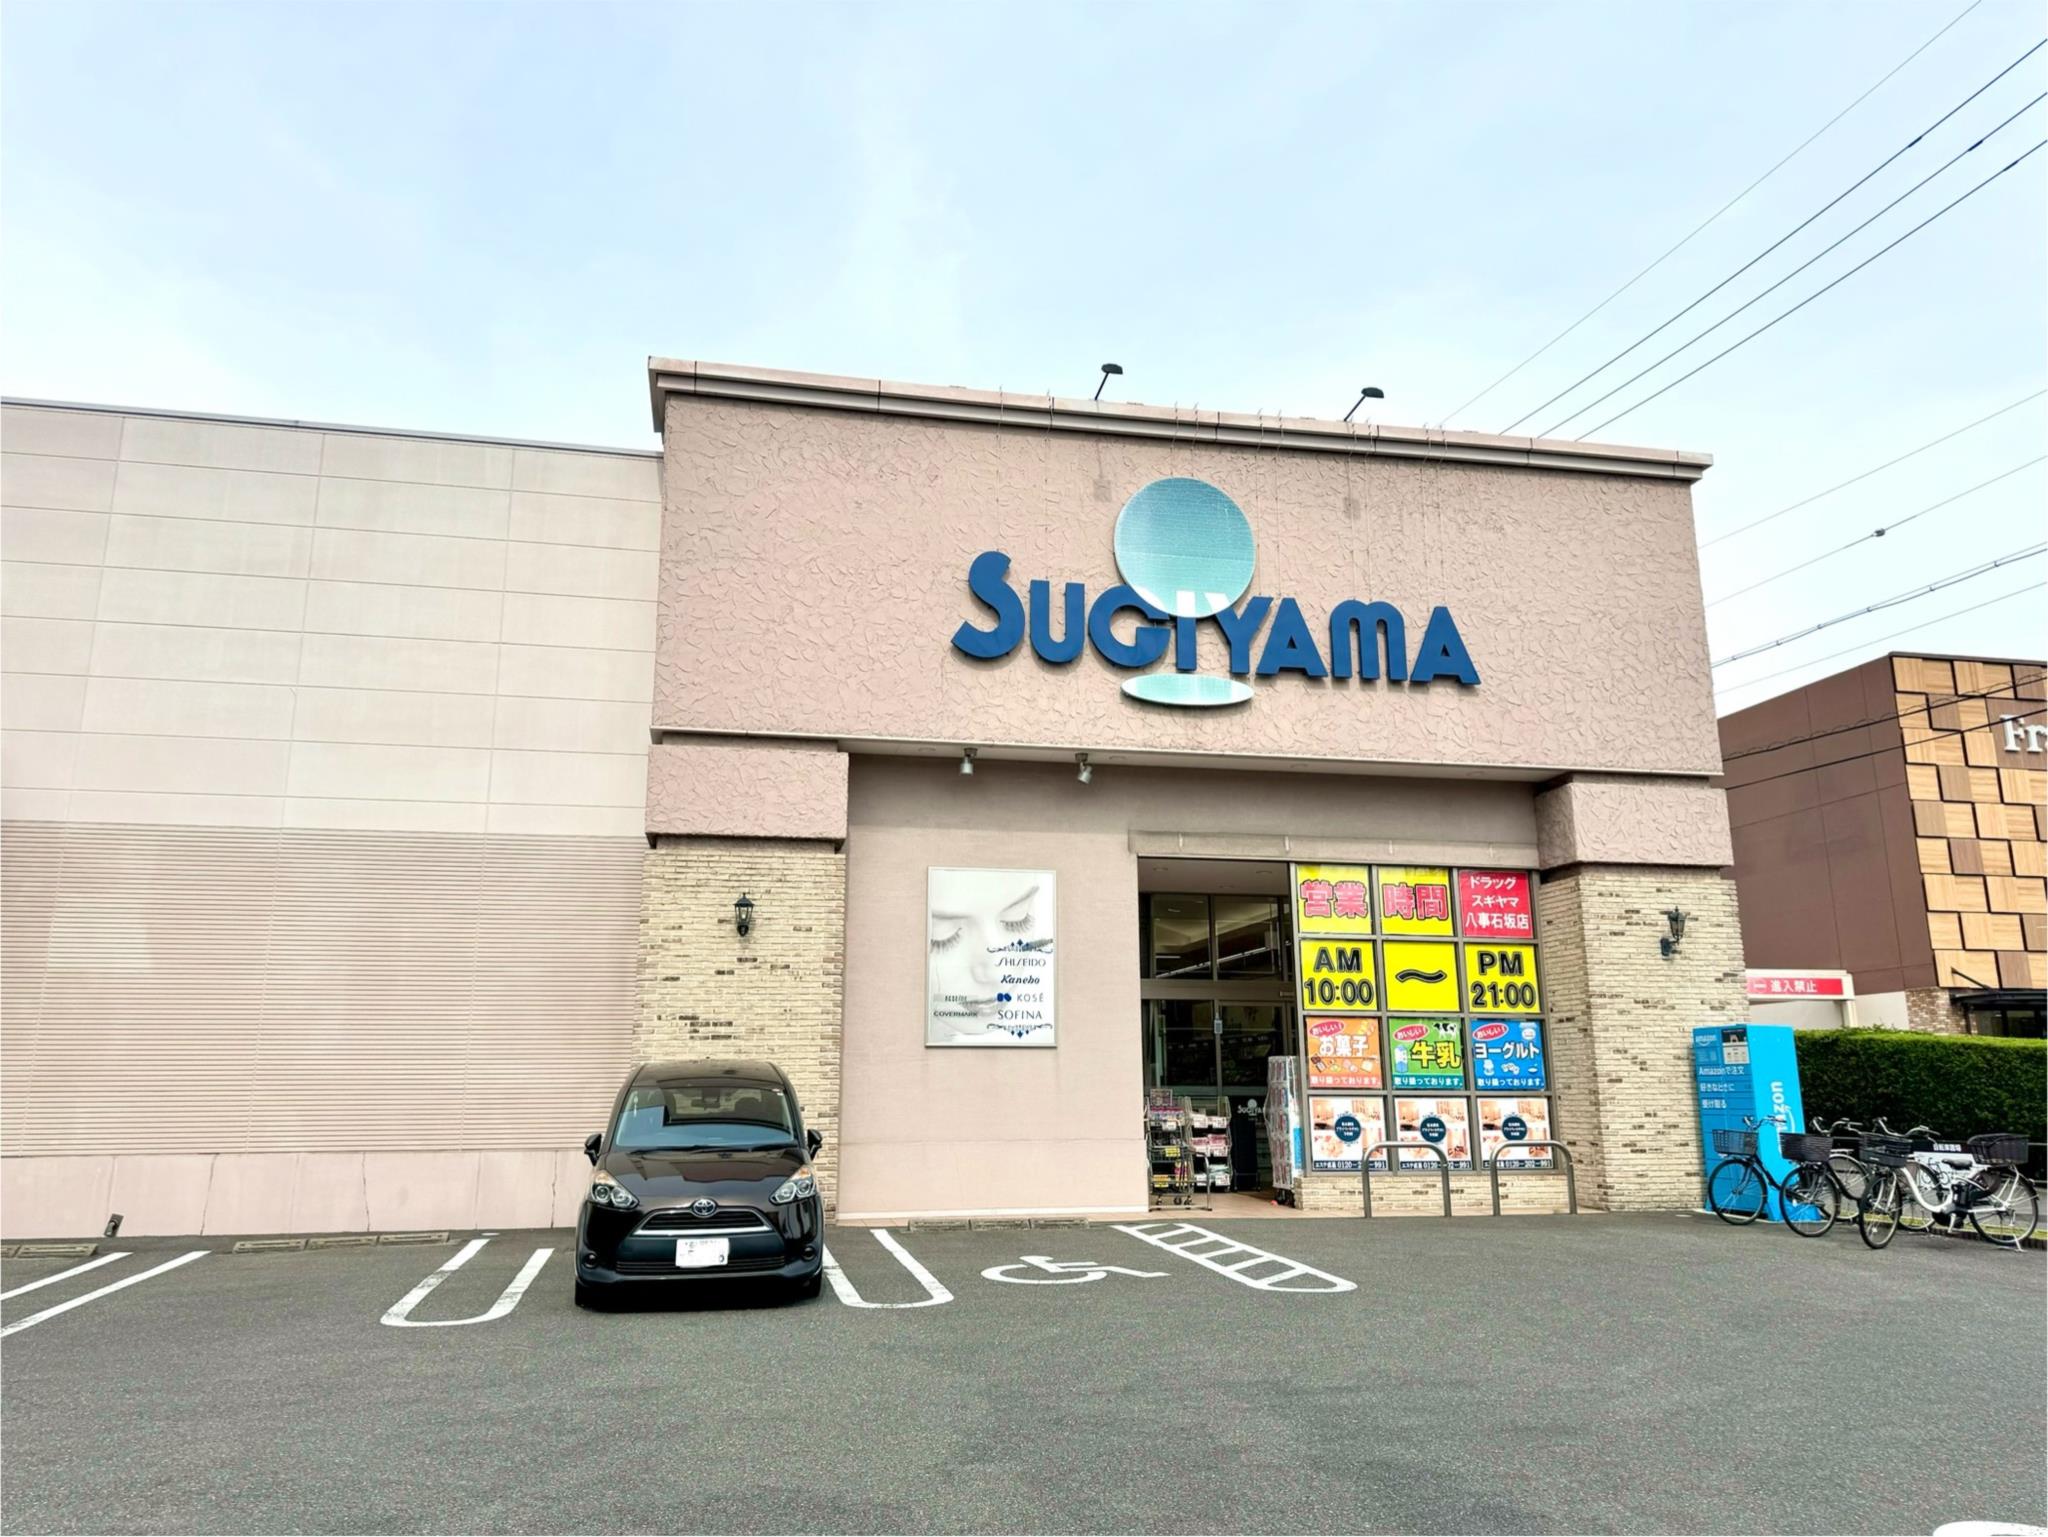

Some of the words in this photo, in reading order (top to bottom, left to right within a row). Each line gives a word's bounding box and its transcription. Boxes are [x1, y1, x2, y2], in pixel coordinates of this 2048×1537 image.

[950, 550, 1481, 686] SUGIYAMA
[1999, 714, 2047, 752] Fr
[1470, 875, 1517, 890] ドラッグ
[1301, 879, 1369, 919] 営業
[1382, 882, 1449, 921] 時間
[1471, 895, 1520, 908] スギヤマ
[1465, 911, 1529, 929] 八事石坂店
[995, 957, 1047, 968] SHISEIDO
[1314, 947, 1362, 973] AM
[1478, 950, 1524, 976] PM
[1000, 974, 1040, 985] Kanebo
[1771, 979, 1818, 993] 進入禁止
[1016, 992, 1045, 1002] KOSÉ
[1304, 977, 1375, 1006] 10:00
[1470, 981, 1536, 1008] 21:00
[997, 1009, 1043, 1020] SOFINA
[1319, 1034, 1369, 1057] お菓子
[1410, 1040, 1461, 1069] 牛乳
[1474, 1042, 1540, 1059] ヨーグルト
